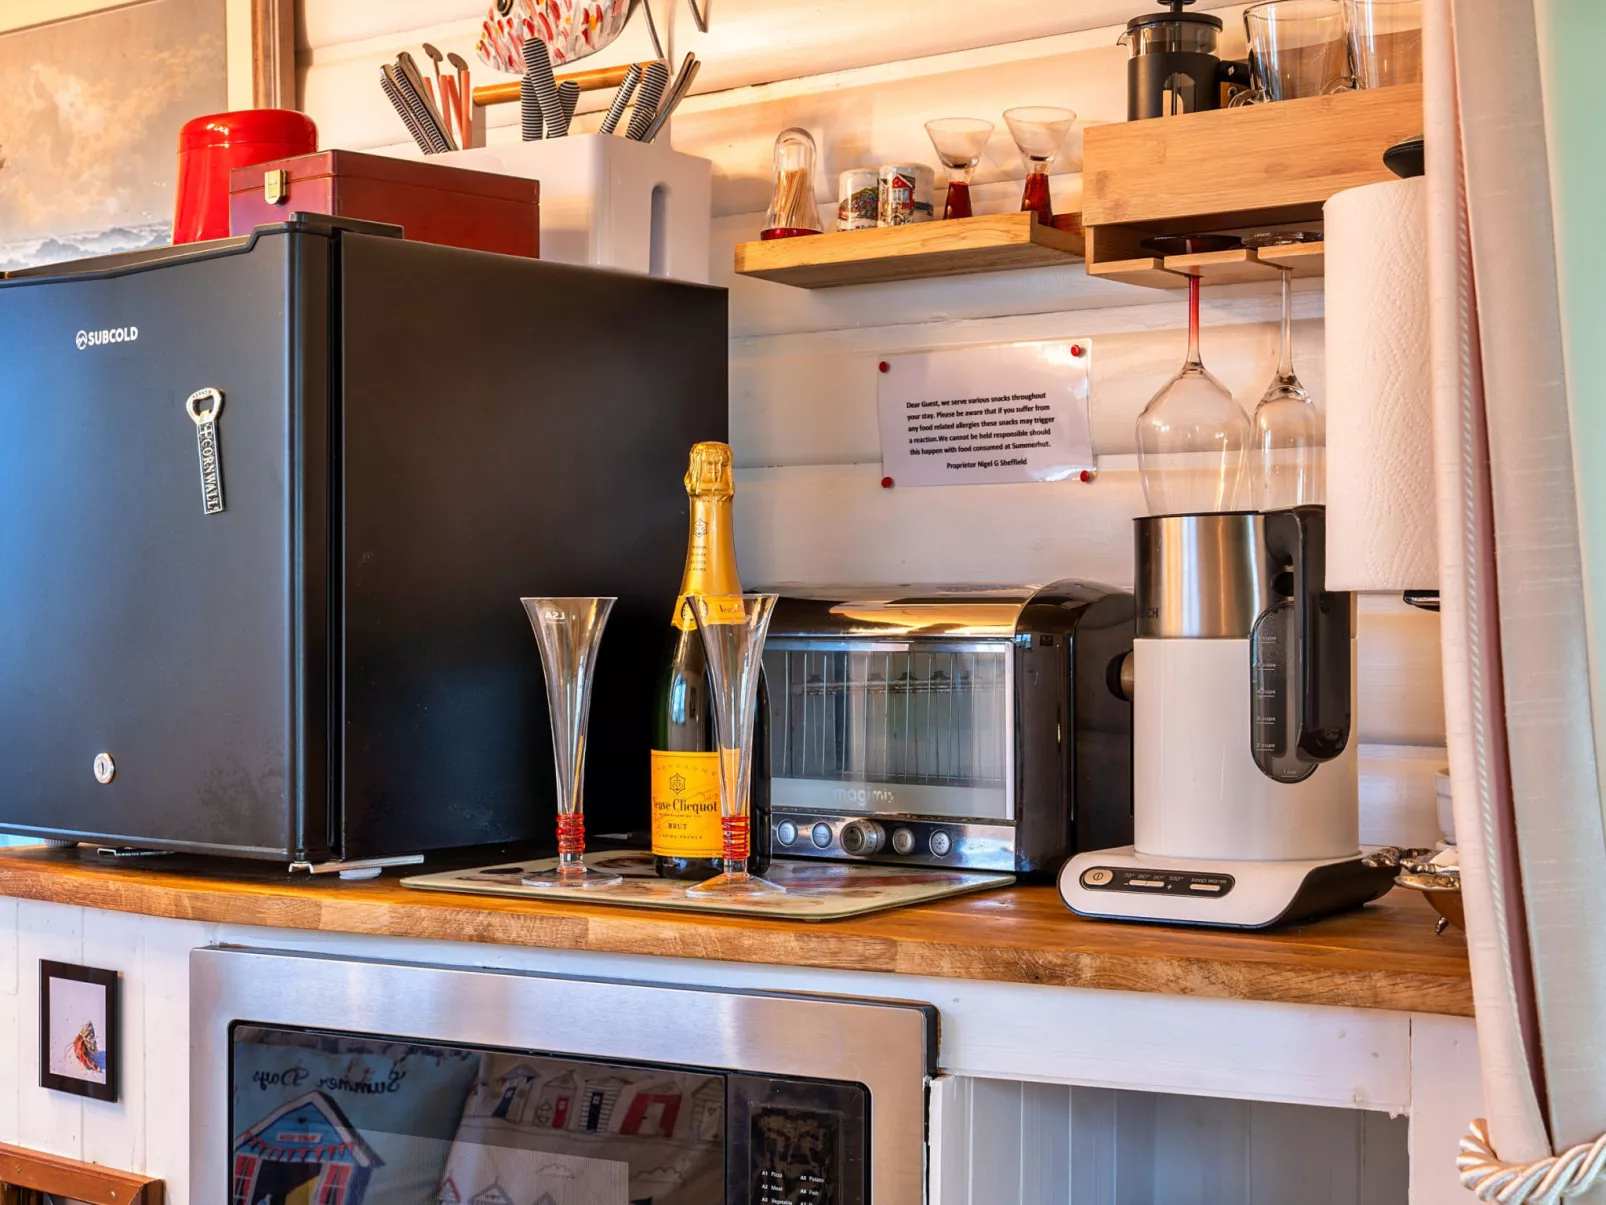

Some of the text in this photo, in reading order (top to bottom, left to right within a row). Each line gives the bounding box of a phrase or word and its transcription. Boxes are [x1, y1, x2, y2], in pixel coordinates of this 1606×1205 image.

[88, 326, 138, 346] SUBCOLD
[1012, 392, 1046, 401] throughout
[956, 421, 980, 429] allergies
[994, 430, 1028, 439] responsible
[1029, 428, 1051, 436] should
[1012, 441, 1051, 449] Summerhut.
[947, 461, 976, 470] Proprietor
[978, 460, 992, 469] Nigel
[1000, 458, 1027, 466] Sheffield
[202, 440, 220, 510] CORNWALL
[672, 798, 717, 814] Clicquot
